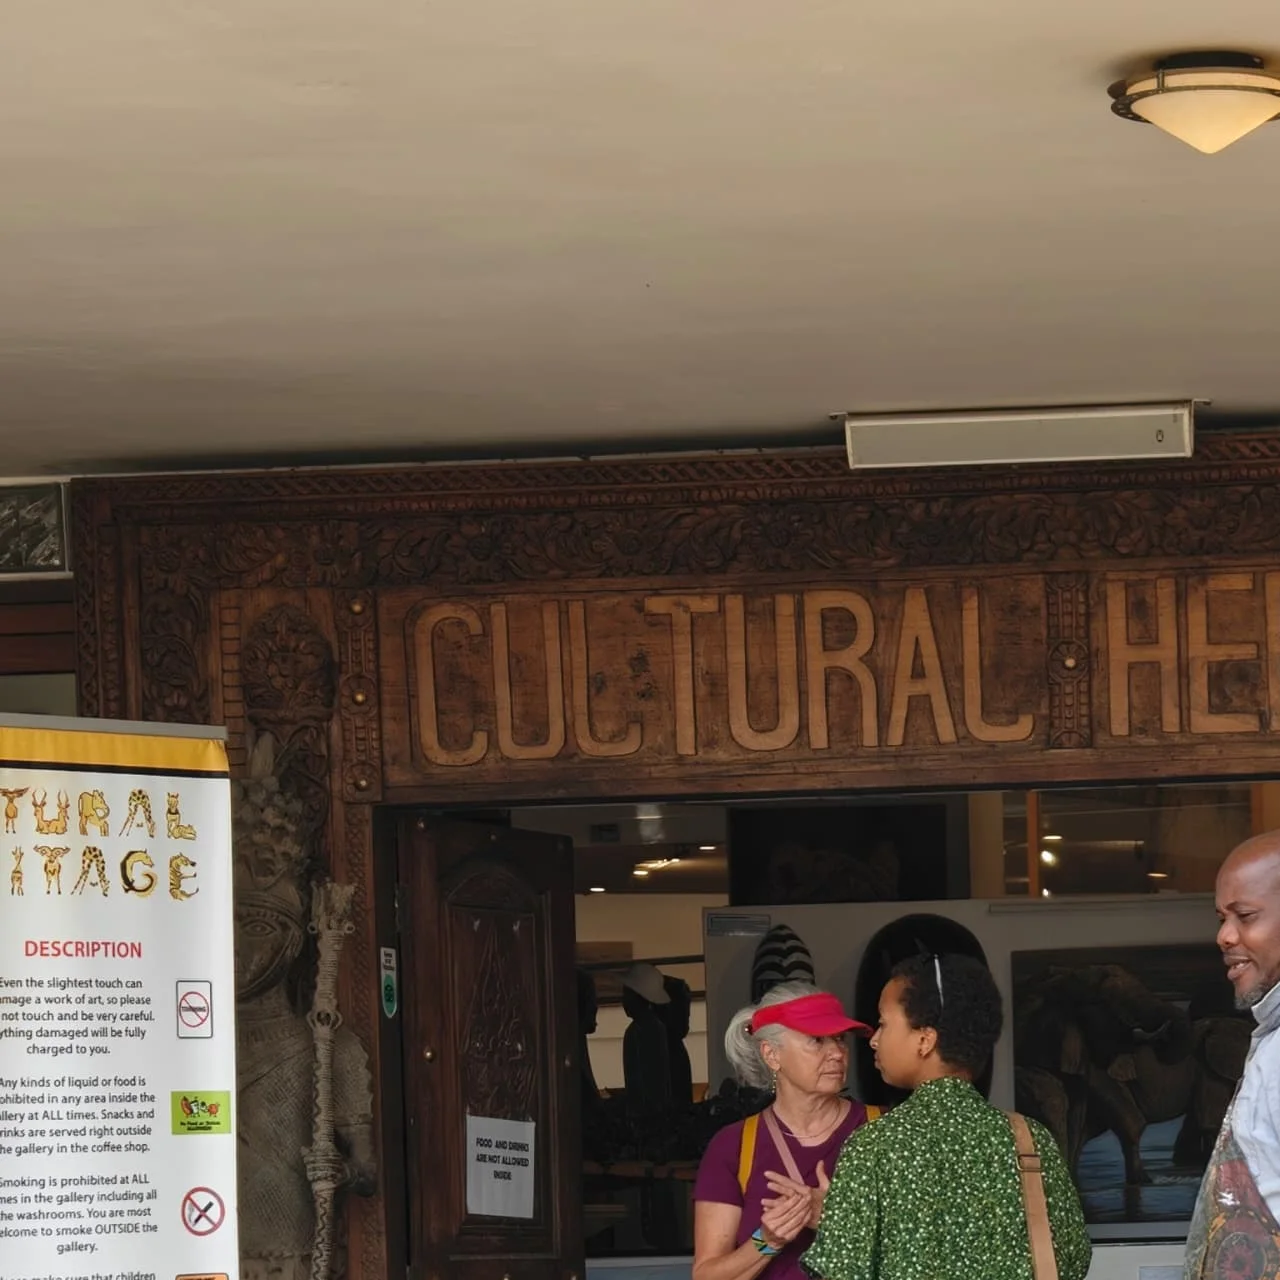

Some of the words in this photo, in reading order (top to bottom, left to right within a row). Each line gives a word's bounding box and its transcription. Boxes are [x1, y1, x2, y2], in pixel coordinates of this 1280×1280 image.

[412, 586, 1034, 767] CULTURAL
[25, 940, 142, 958] DESCRIPTION
[47, 977, 93, 990] slightest
[94, 978, 123, 989] touch
[125, 980, 142, 988] can
[44, 994, 72, 1004] work
[120, 994, 151, 1007] please
[1, 1011, 19, 1021] not
[22, 1010, 54, 1021] touch
[57, 1010, 78, 1021] and
[96, 1012, 117, 1023] very
[119, 1010, 154, 1021] careful.
[35, 1027, 88, 1040] damaged
[90, 1026, 108, 1038] will
[124, 1026, 146, 1040] fully
[26, 1043, 73, 1057] charged
[20, 1076, 51, 1087] kinds
[68, 1076, 99, 1089] liquid
[113, 1075, 136, 1087] food
[61, 1095, 81, 1106] any
[84, 1095, 106, 1104] area
[108, 1092, 138, 1103] inside
[139, 1092, 155, 1103] the
[41, 1110, 64, 1120] ALL
[65, 1110, 99, 1120] times.
[100, 1108, 134, 1120] Snacks
[136, 1108, 155, 1119] and
[28, 1129, 46, 1137] are
[49, 1126, 86, 1137] served
[89, 1125, 114, 1139] right
[116, 1124, 152, 1136] outside
[14, 1143, 54, 1157] gallery
[70, 1142, 88, 1153] the
[91, 1141, 122, 1152] coffee
[124, 1141, 150, 1153] shop.
[60, 1175, 117, 1188] prohibited
[131, 1173, 150, 1184] ALL
[34, 1192, 53, 1203] the
[56, 1191, 95, 1205] gallery
[97, 1190, 144, 1203] including
[146, 1189, 157, 1200] all
[16, 1209, 84, 1220] washrooms.
[86, 1208, 107, 1219] You
[108, 1209, 125, 1218] are
[126, 1207, 151, 1217] most
[56, 1225, 92, 1236] smoke
[94, 1222, 140, 1235] OUTSIDE
[142, 1222, 158, 1232] the
[56, 1241, 98, 1255] gallery.
